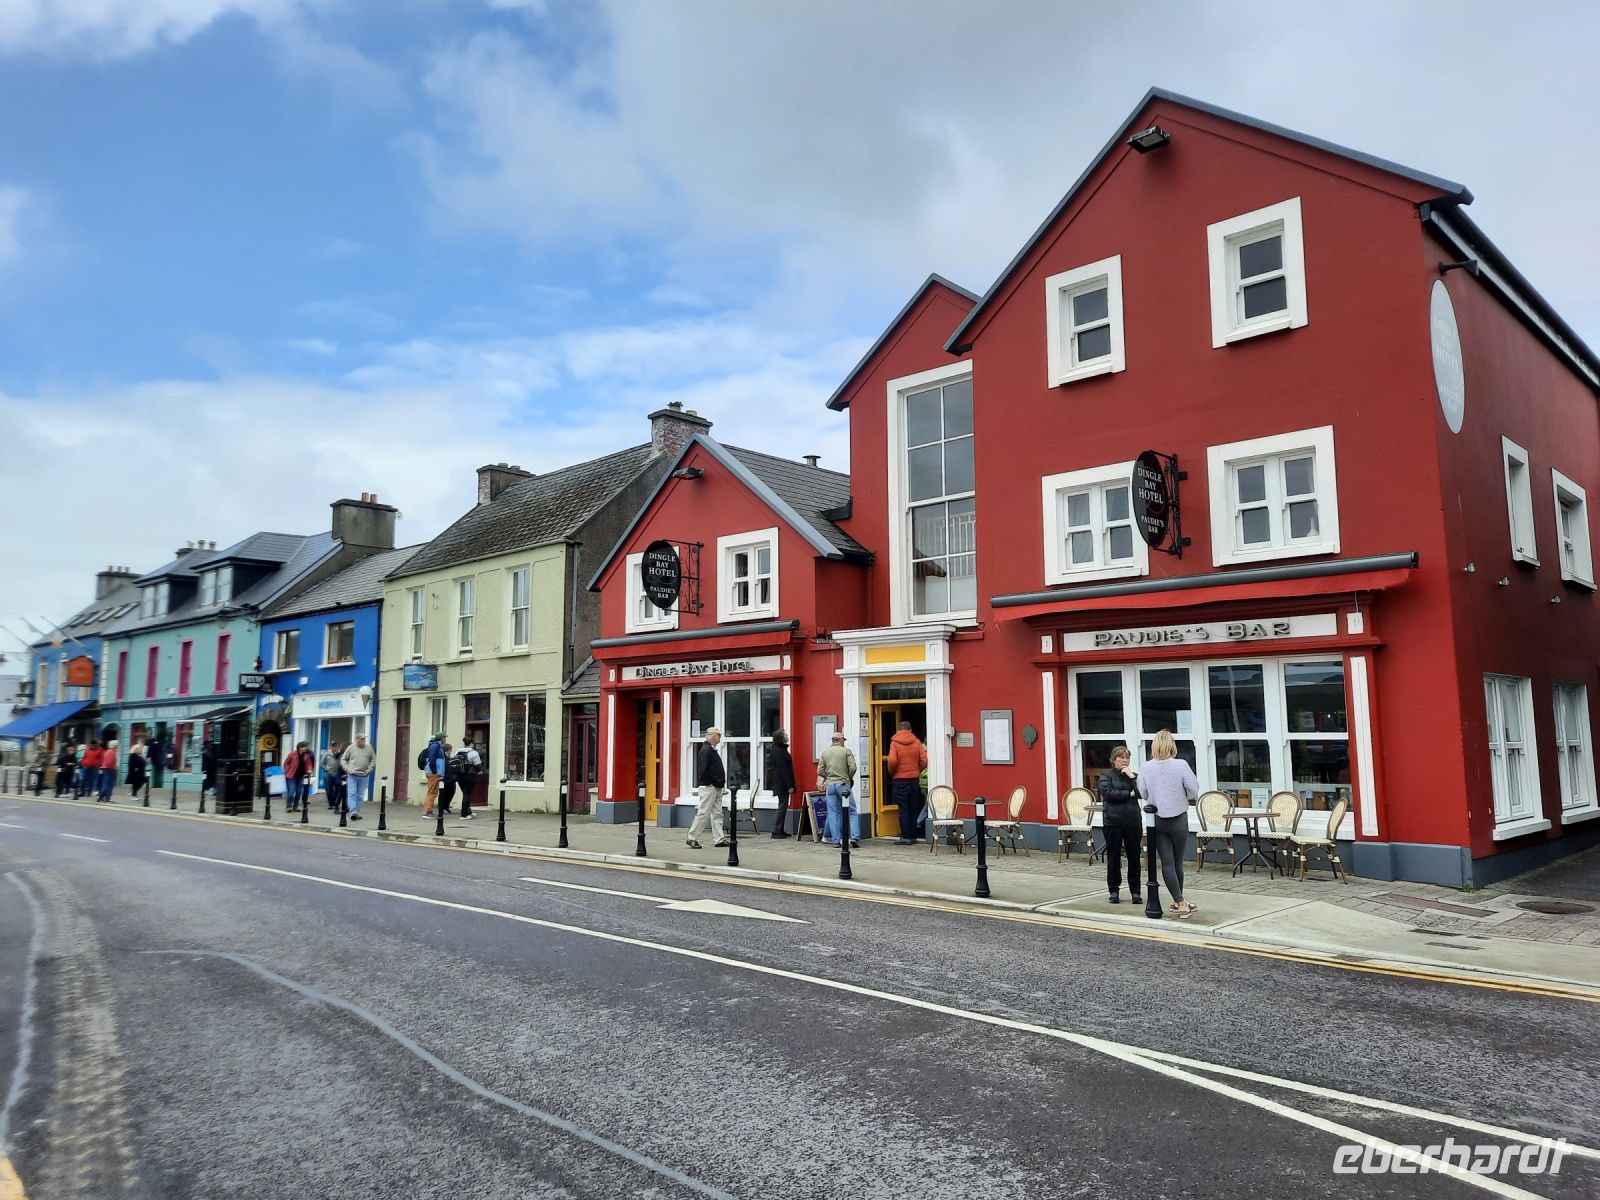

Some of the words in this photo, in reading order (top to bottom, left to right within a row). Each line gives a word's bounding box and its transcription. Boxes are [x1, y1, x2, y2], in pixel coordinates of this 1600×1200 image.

[1138, 467, 1162, 482] DINGLE
[1144, 479, 1156, 490] BAY
[1138, 488, 1163, 504] HOTEL
[1141, 515, 1164, 528] PAUDIE'S
[1148, 525, 1158, 534] BAR
[649, 552, 676, 562] DINGLE
[649, 567, 676, 577] HOTEL
[650, 586, 676, 594] PAUDIE'S
[1094, 627, 1210, 647] PAUDIE'S
[1226, 622, 1290, 640] BAR
[682, 663, 709, 675] BAY
[712, 660, 755, 673] HOTEL
